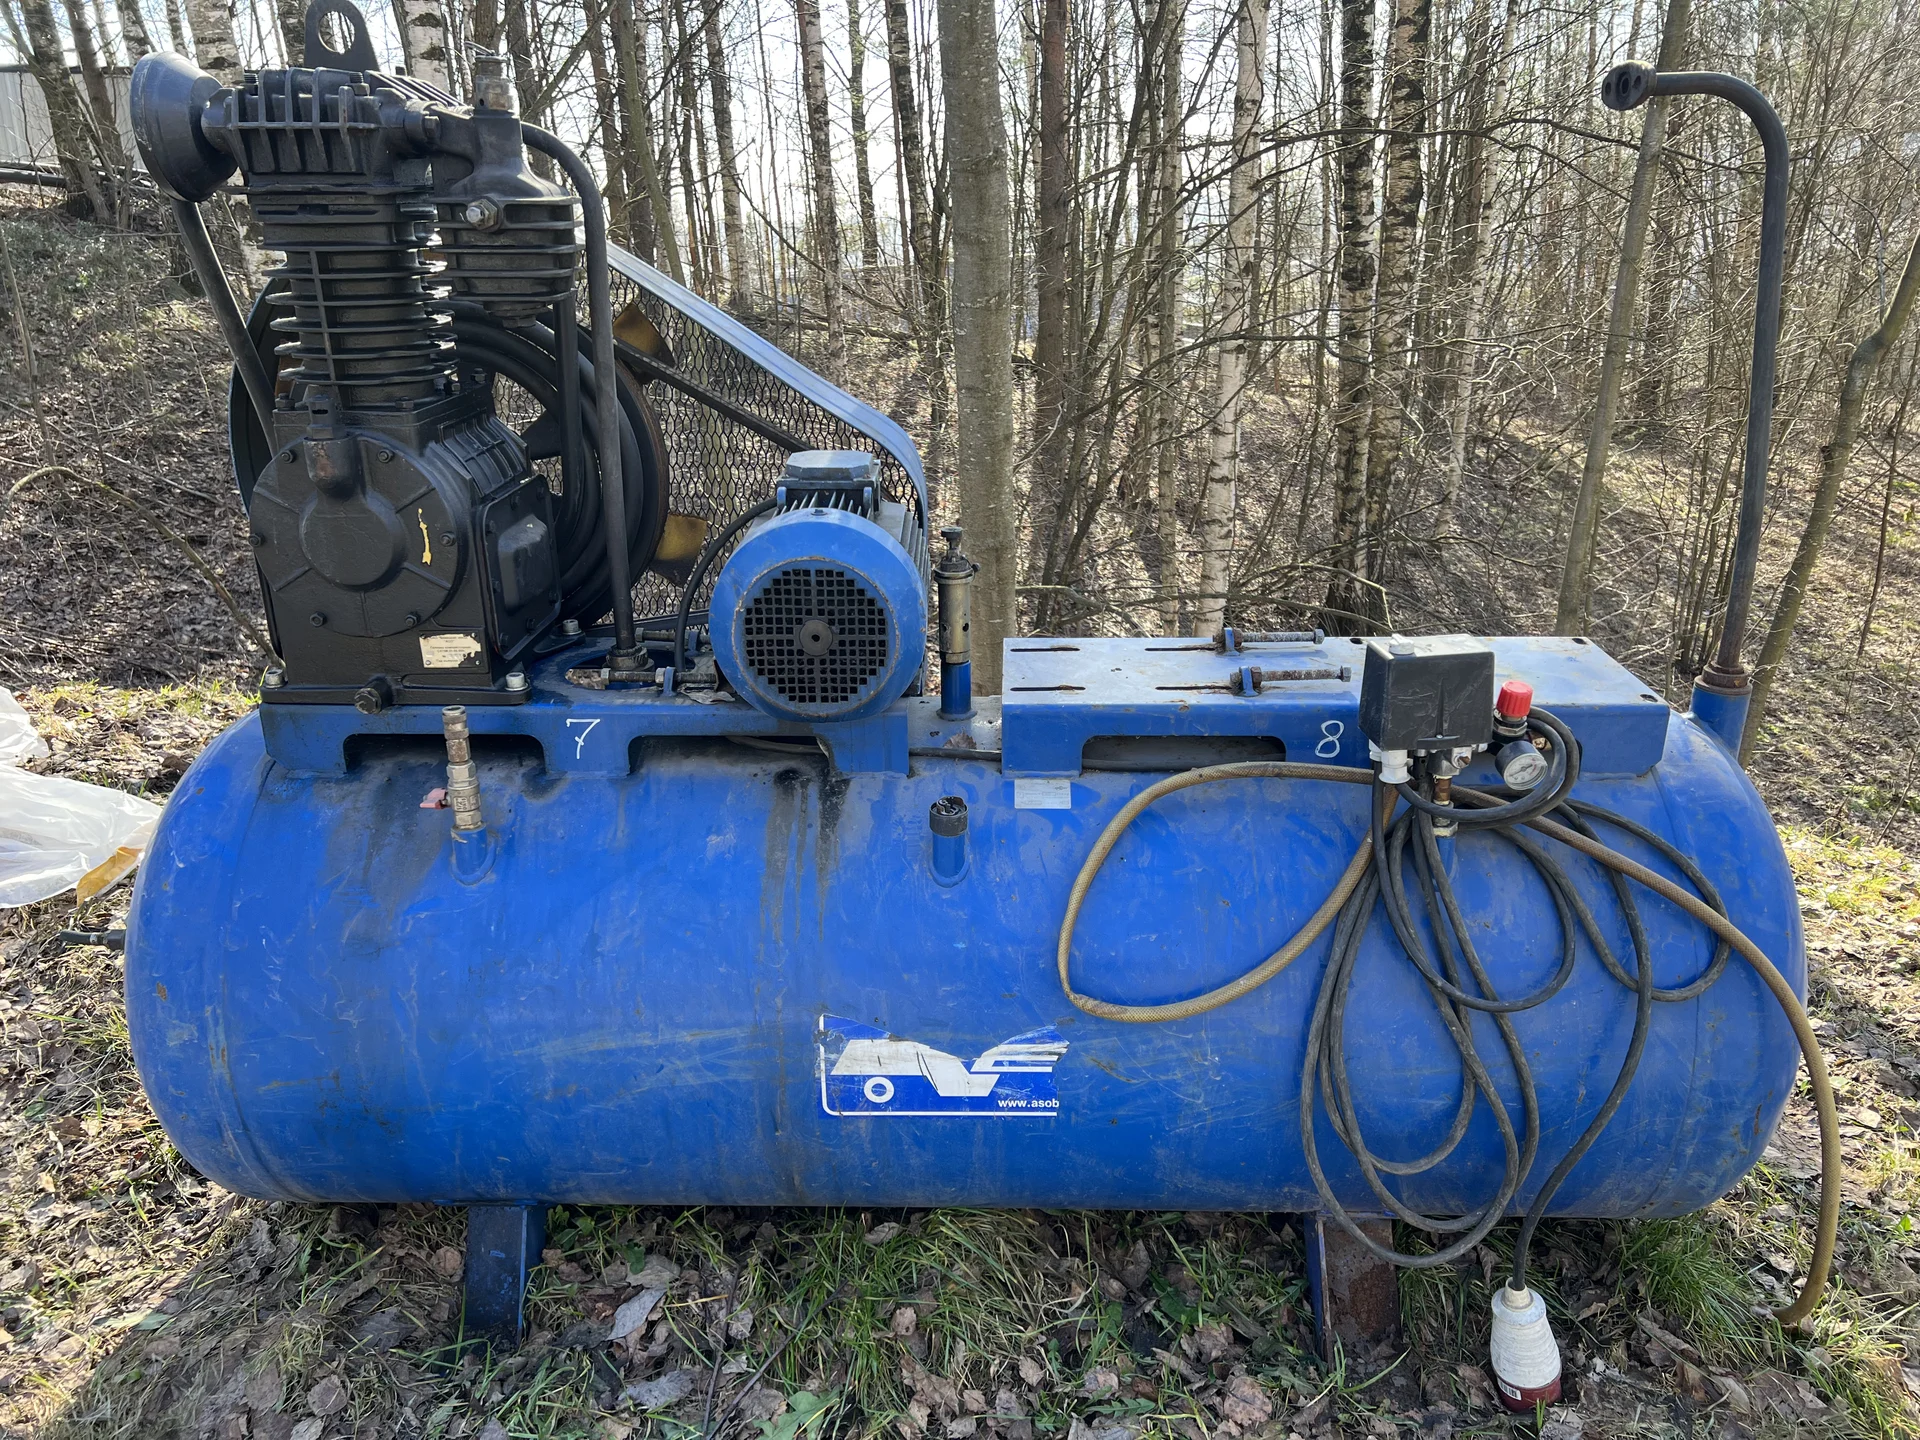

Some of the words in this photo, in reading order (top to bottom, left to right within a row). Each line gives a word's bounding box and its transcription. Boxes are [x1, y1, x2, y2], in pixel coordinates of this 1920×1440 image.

[566, 718, 601, 760] 7
[1315, 720, 1345, 758] 8
[998, 1098, 1060, 1108] www.asob
